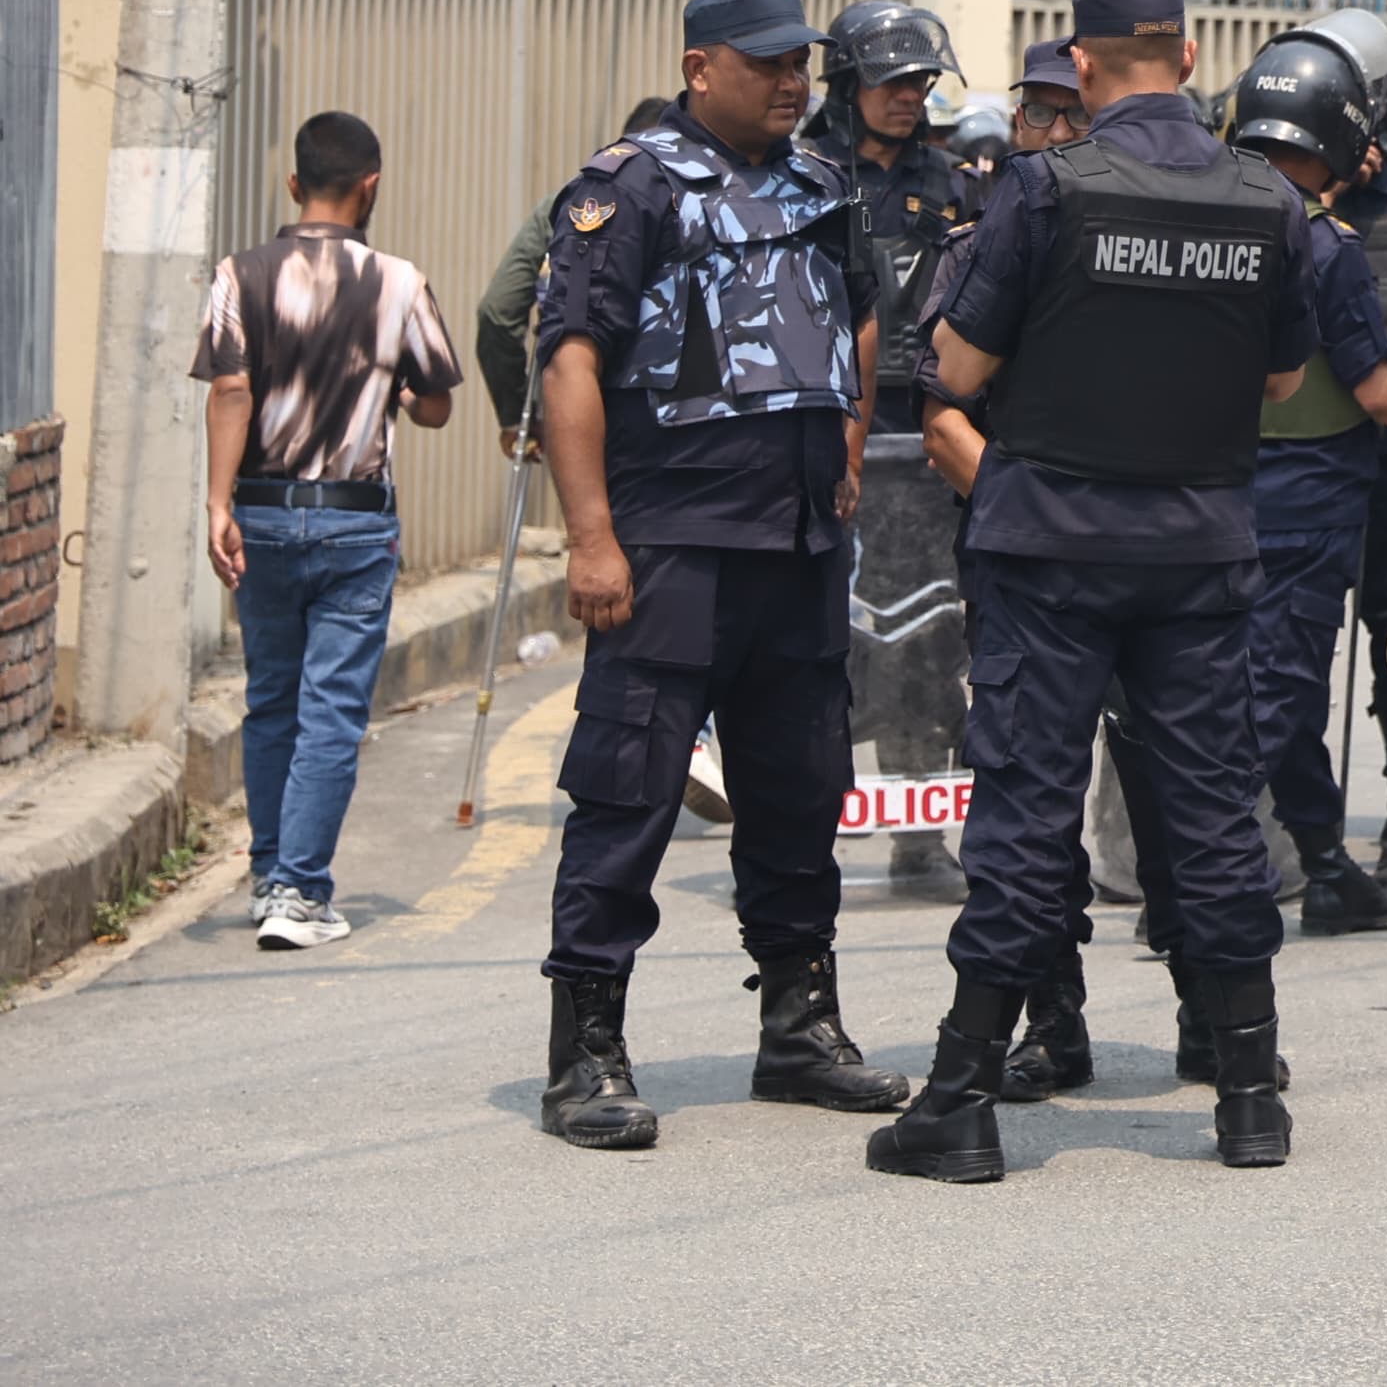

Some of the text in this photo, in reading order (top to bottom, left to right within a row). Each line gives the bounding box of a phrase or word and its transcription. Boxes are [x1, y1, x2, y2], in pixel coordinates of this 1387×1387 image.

[1256, 75, 1299, 93] POLICE
[1095, 234, 1262, 282] NEPAL POLICE
[840, 783, 975, 828] OLICE
